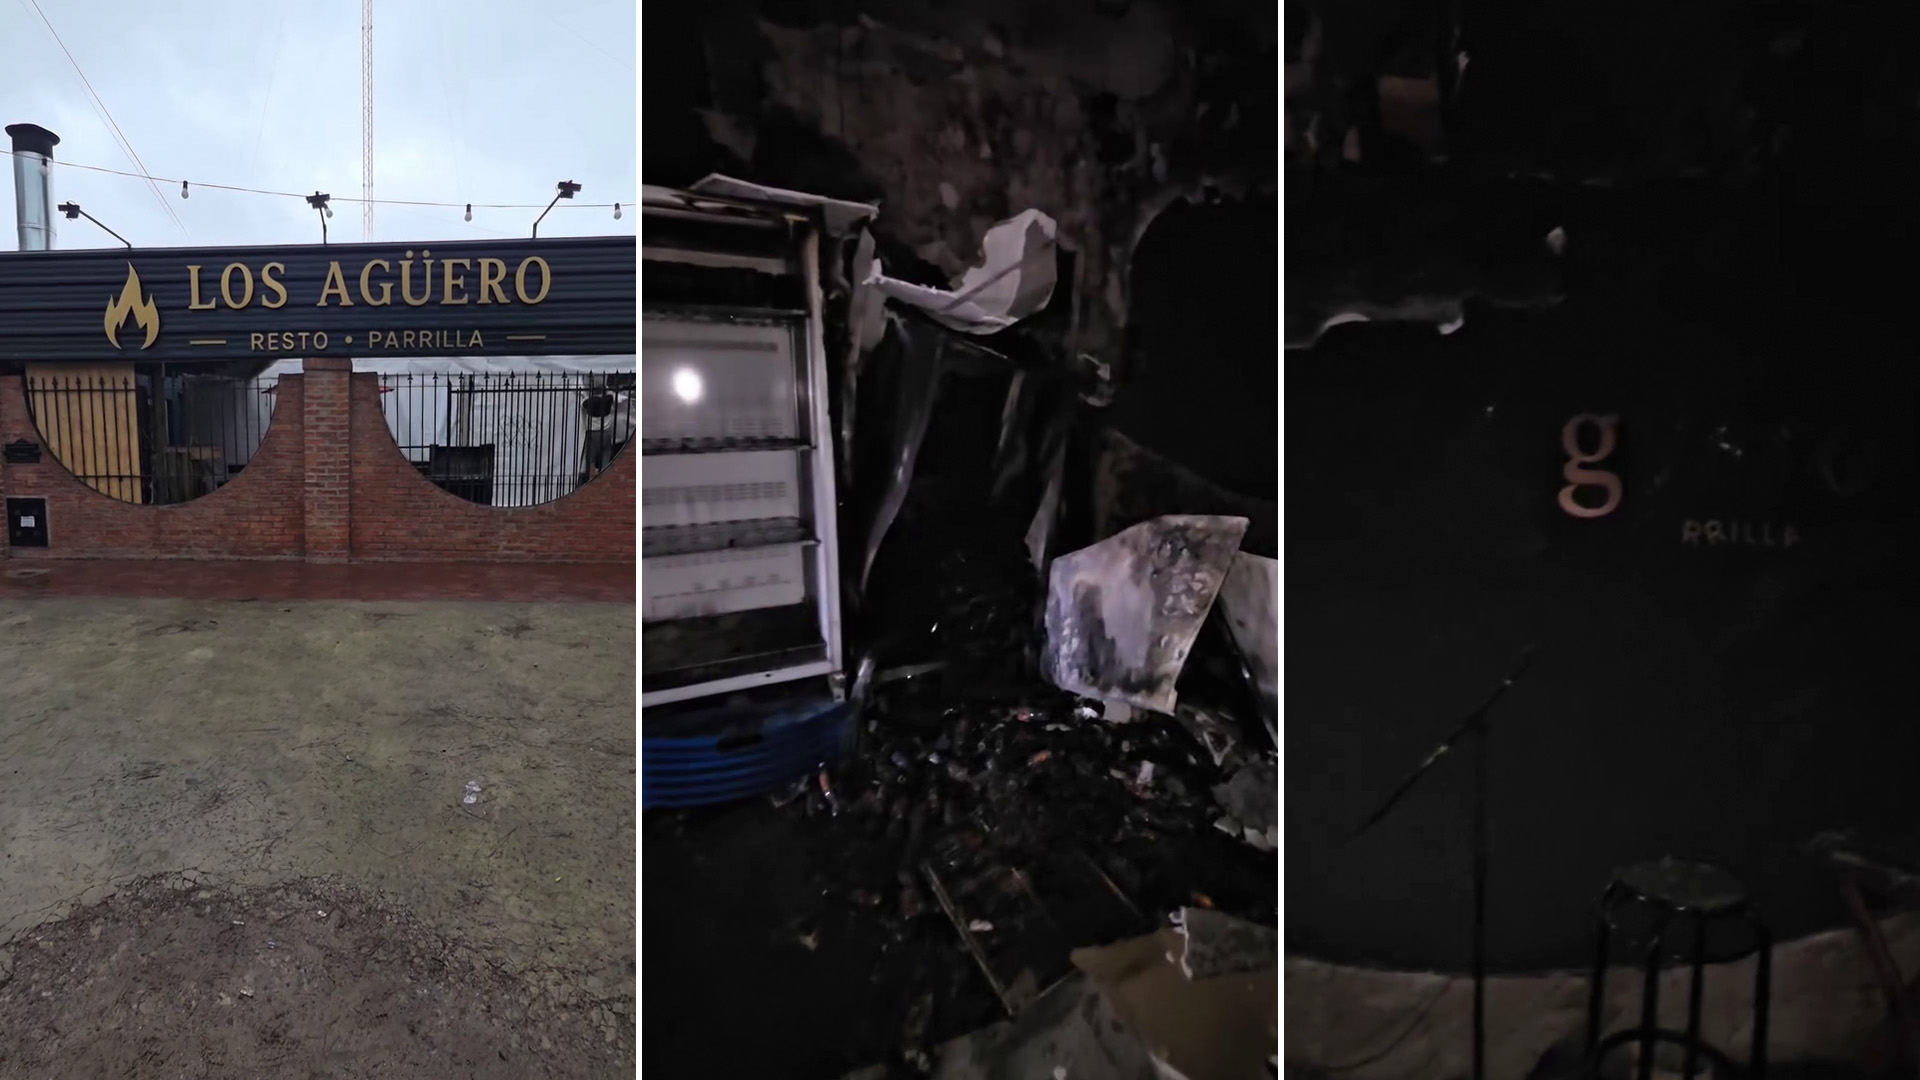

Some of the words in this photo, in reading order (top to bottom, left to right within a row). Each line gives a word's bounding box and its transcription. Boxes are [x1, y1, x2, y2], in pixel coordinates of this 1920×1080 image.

[187, 263, 287, 309] LOS
[317, 250, 551, 306] AGÜERO
[250, 332, 328, 352] RESTO
[369, 330, 484, 350] PARRILLA
[1557, 413, 1623, 518] g
